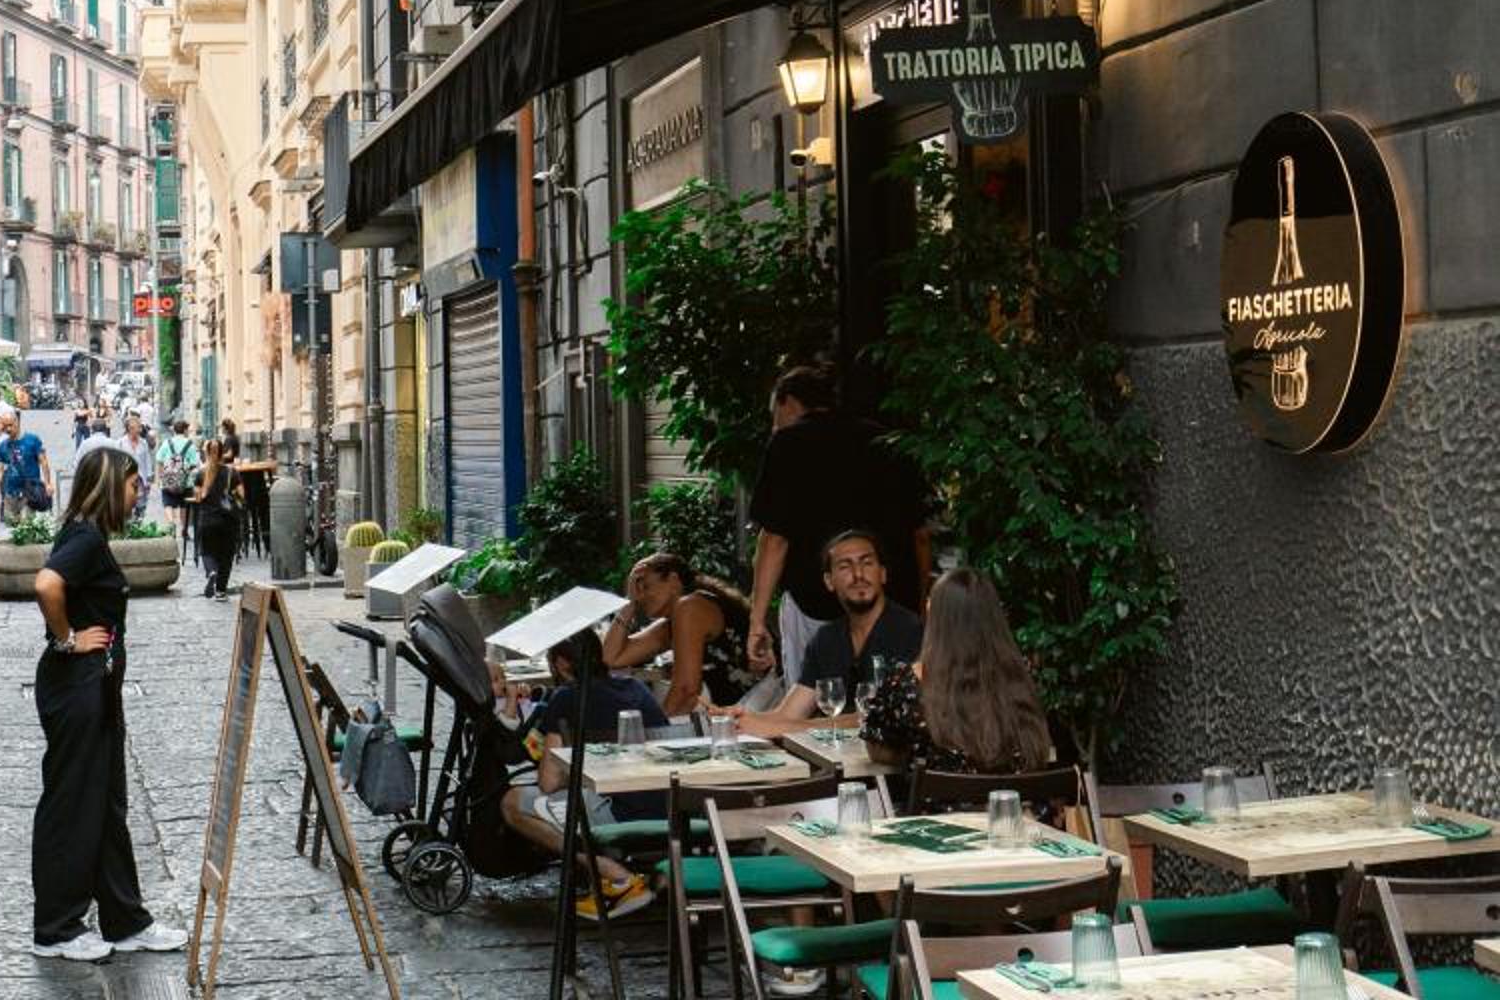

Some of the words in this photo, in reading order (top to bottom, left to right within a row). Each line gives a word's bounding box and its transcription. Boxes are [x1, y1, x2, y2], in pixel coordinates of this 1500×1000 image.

[883, 45, 1007, 81] TRATTORIA
[1010, 39, 1087, 74] TIPICA
[1228, 282, 1353, 322] FIASCHETTERIA
[1254, 321, 1326, 350] Agricola
